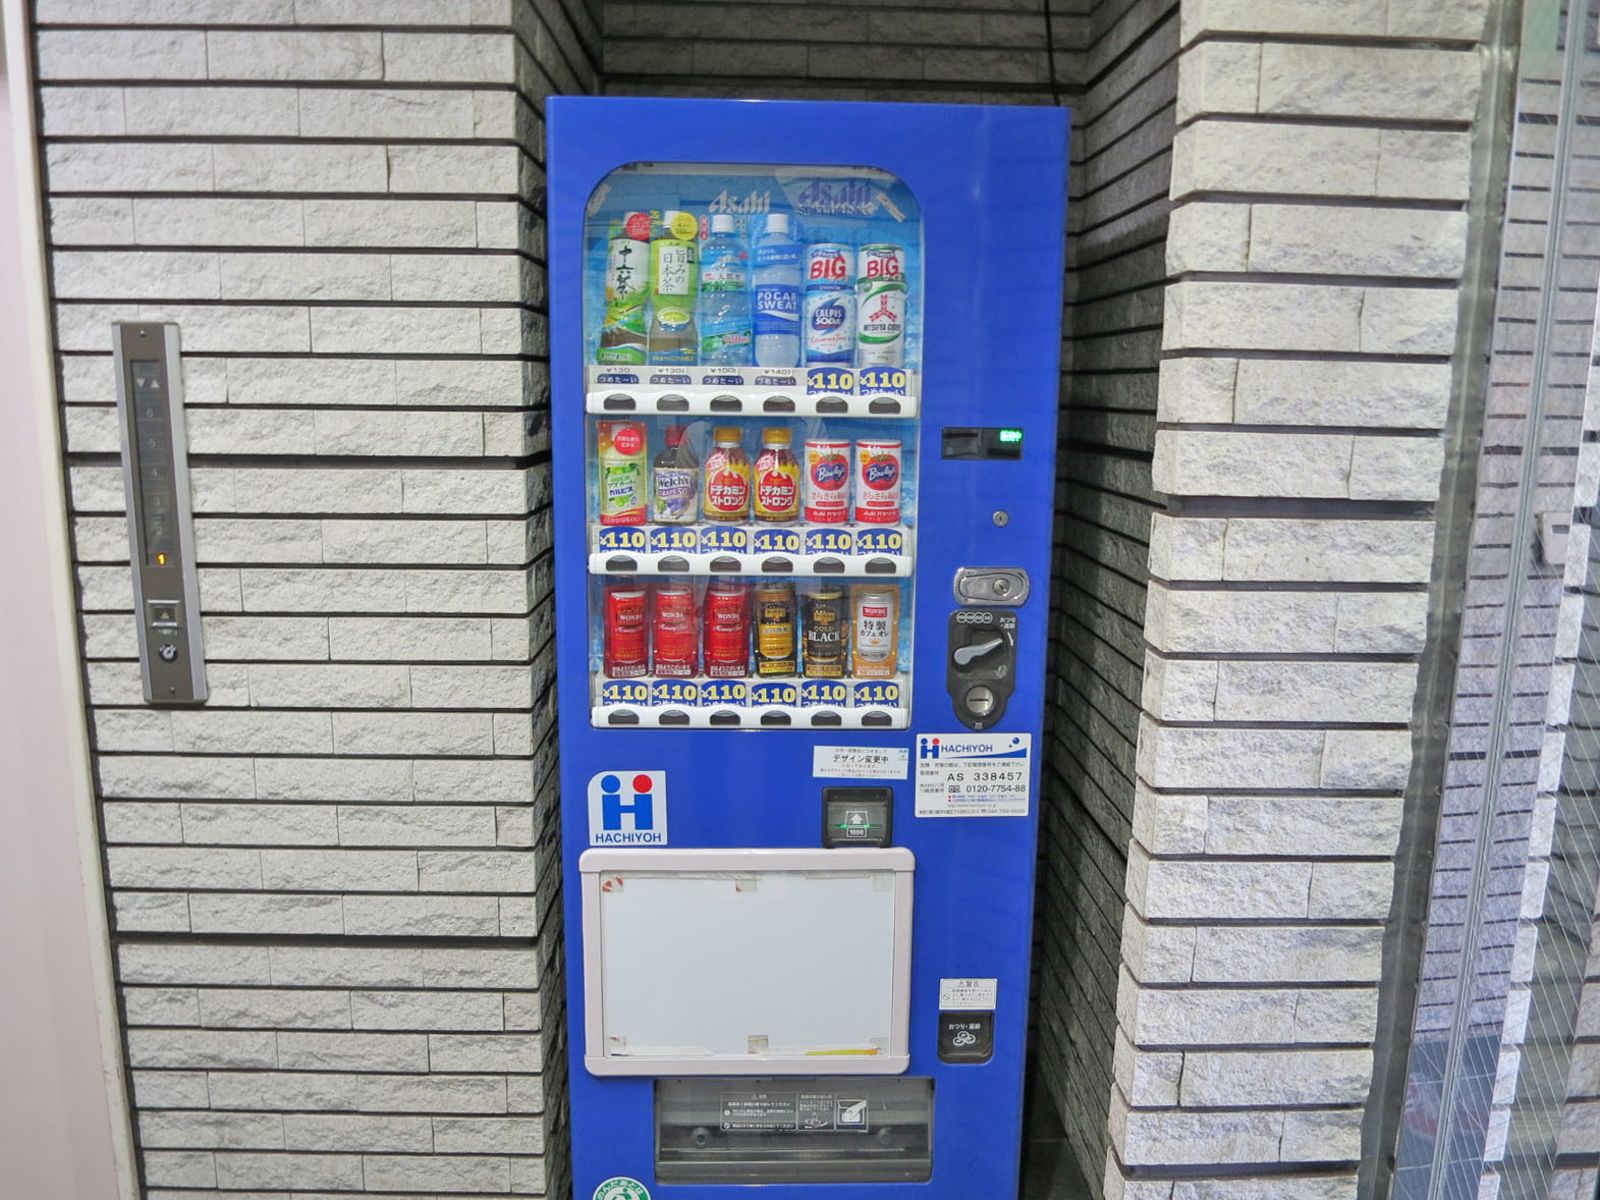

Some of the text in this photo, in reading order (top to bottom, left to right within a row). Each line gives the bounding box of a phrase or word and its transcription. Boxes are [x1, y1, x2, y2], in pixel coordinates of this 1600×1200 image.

[709, 190, 770, 213] Asahi
[616, 245, 636, 300] 十六茶
[662, 253, 675, 293] 日本茶
[675, 248, 686, 284] 旨みの
[810, 256, 846, 279] BIG
[867, 256, 899, 278] BIG
[757, 301, 797, 310] SWEAT
[815, 309, 842, 318] CALPIS
[808, 372, 854, 389] ¥110
[860, 372, 905, 388] ¥110
[658, 477, 689, 488] Welch's
[710, 486, 746, 496] ドデカミン
[760, 486, 794, 496] ドデカミン
[711, 495, 745, 506] ストロング
[761, 495, 793, 506] ストロング
[600, 532, 645, 548] ¥110
[651, 532, 696, 548] ¥110
[701, 531, 746, 547] ¥110
[754, 534, 799, 550] ¥110
[806, 533, 851, 549] ¥110
[857, 533, 902, 549] ¥110
[157, 553, 165, 566] 1
[863, 620, 887, 632] 特製
[808, 631, 840, 642] BLACK
[603, 685, 648, 700] ¥110
[653, 684, 697, 700] ¥110
[702, 684, 746, 700] ¥110
[752, 688, 796, 703] ¥110
[802, 685, 846, 700] ¥110
[855, 685, 898, 701] ¥110
[941, 744, 993, 753] HACHIYOH
[832, 754, 889, 764] デザイン変更中
[947, 772, 1023, 781] AS 338457
[966, 784, 1026, 793] 0120-7754-88
[595, 833, 662, 843] HACHIYOH
